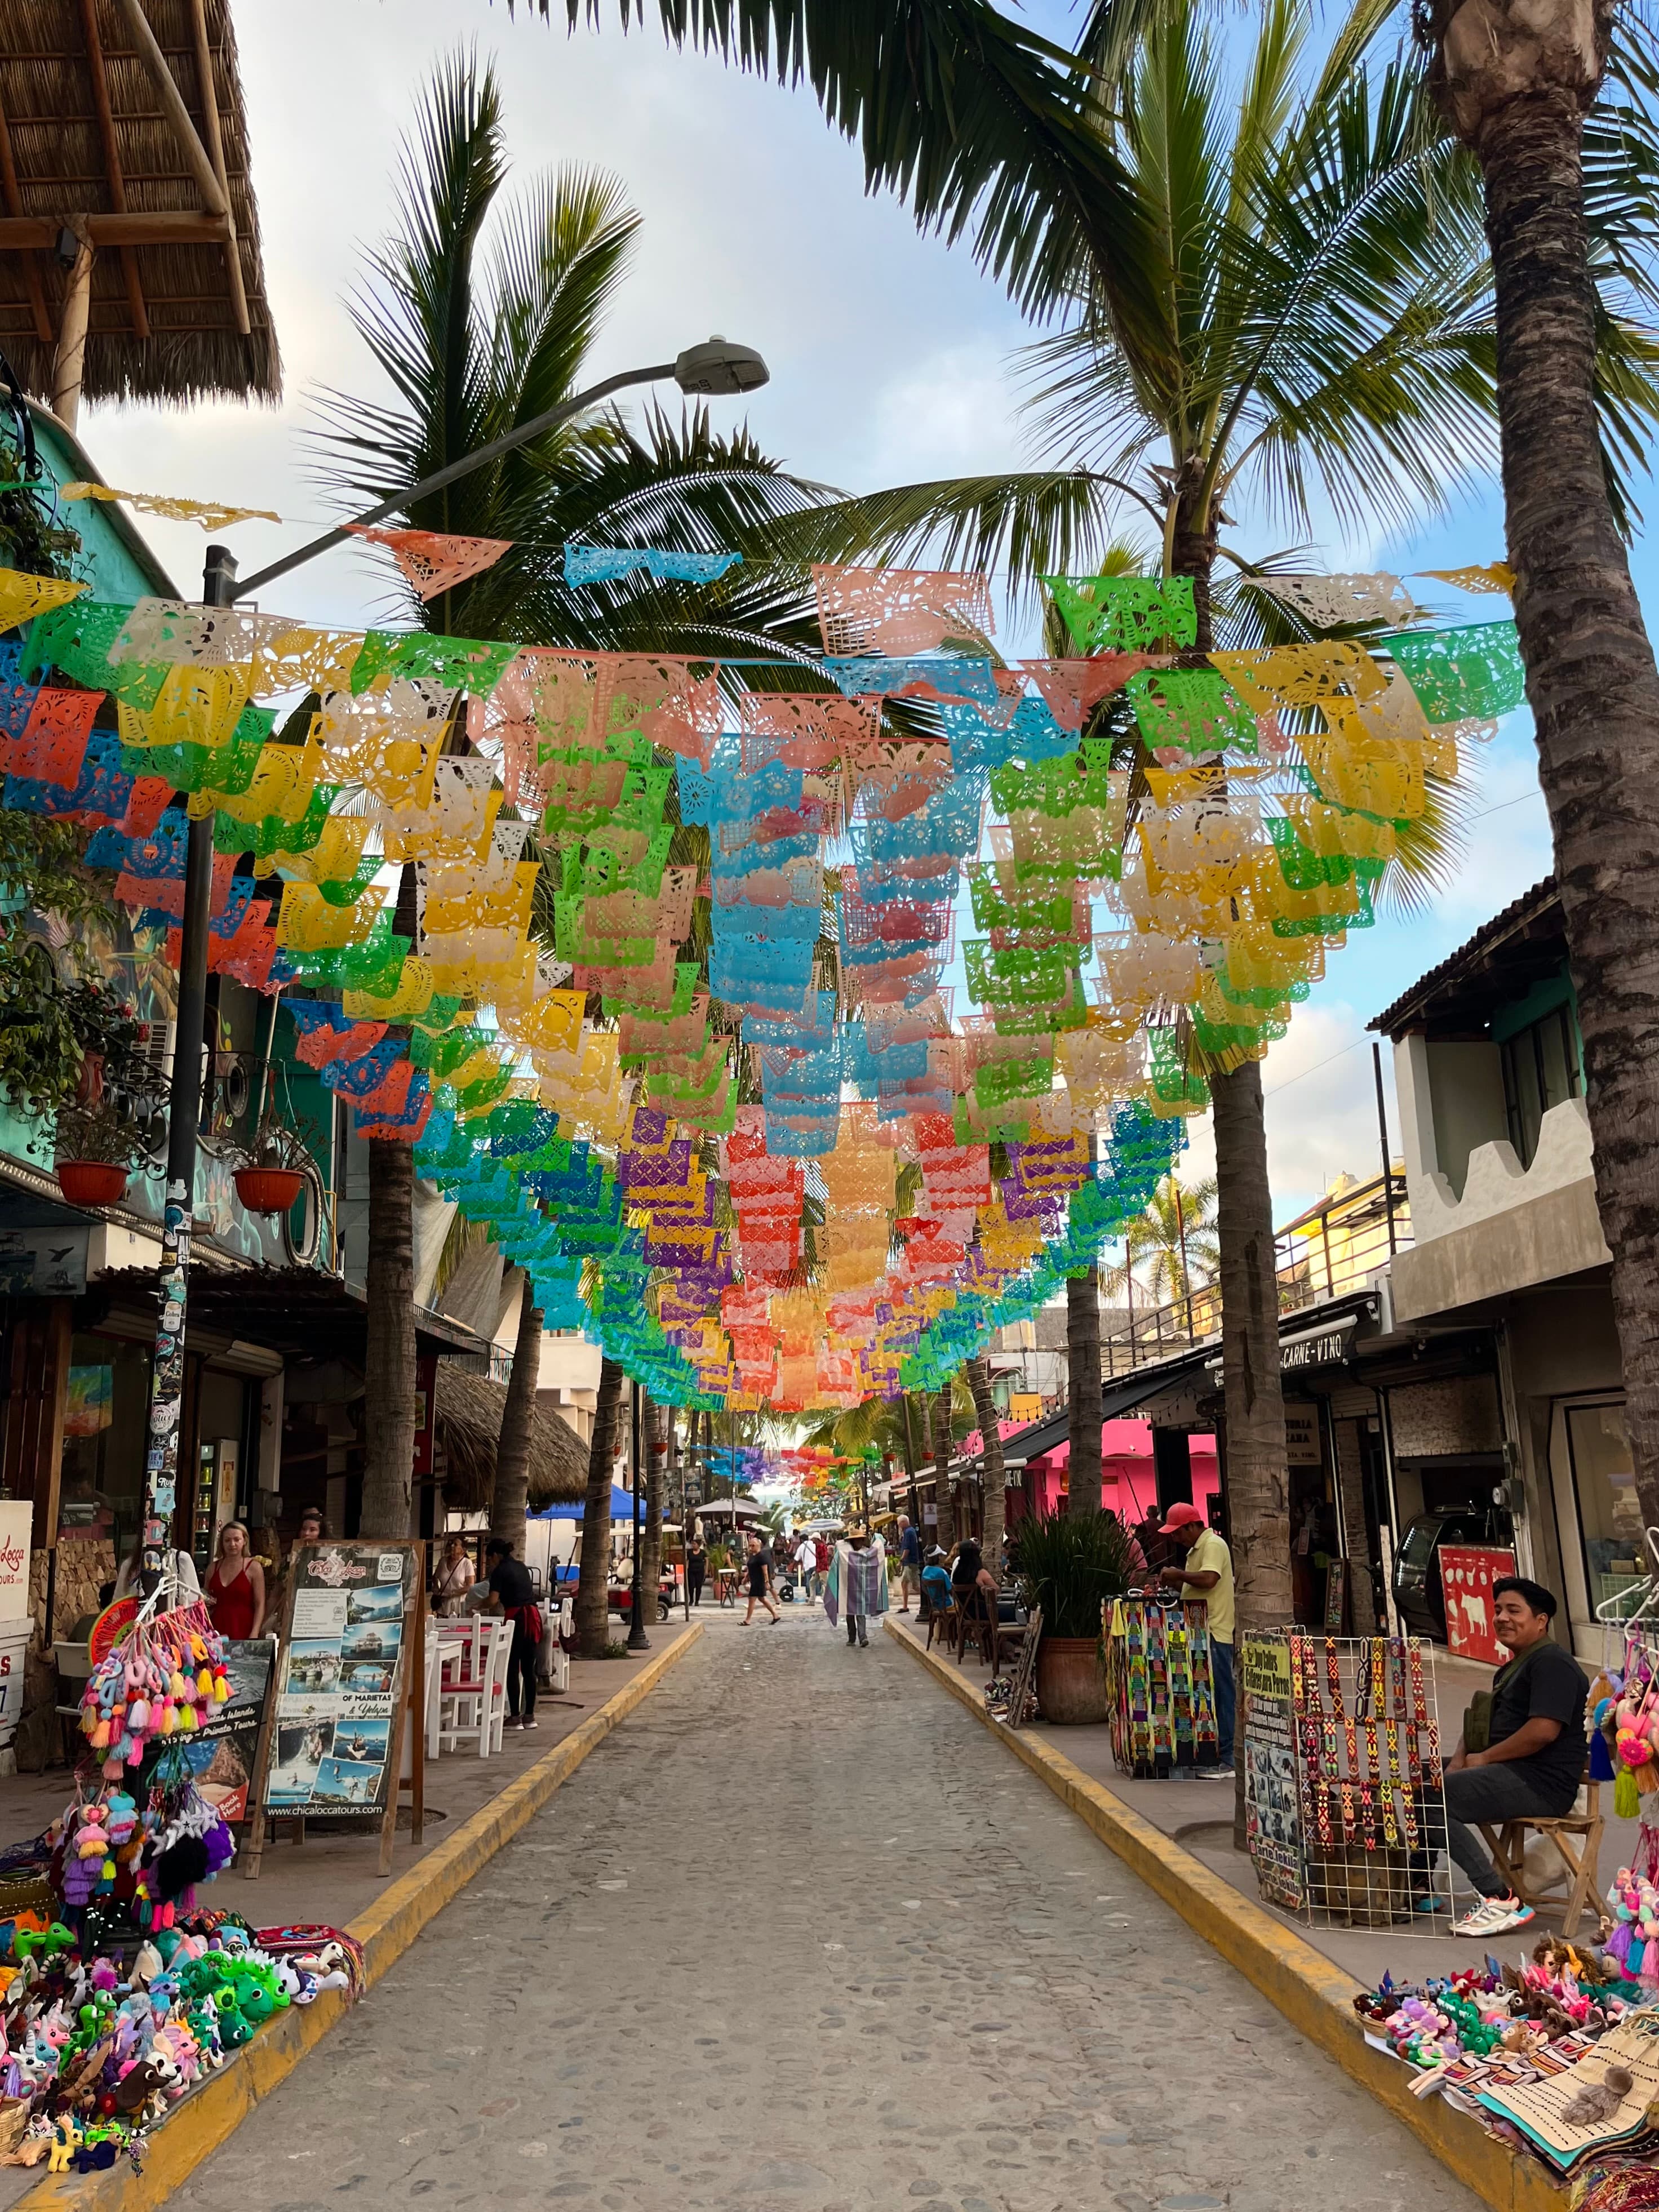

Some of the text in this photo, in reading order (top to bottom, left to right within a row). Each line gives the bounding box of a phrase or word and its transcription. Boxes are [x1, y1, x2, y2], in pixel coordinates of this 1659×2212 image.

[1283, 1334, 1341, 1369] CARNE-VINO
[227, 1706, 255, 1720] Islands
[202, 1724, 232, 1737] Private
[234, 1720, 258, 1730] Tours
[219, 1794, 239, 1812] Book
[222, 1802, 242, 1818] Here
[267, 1804, 383, 1816] www.chicaloccatours.com
